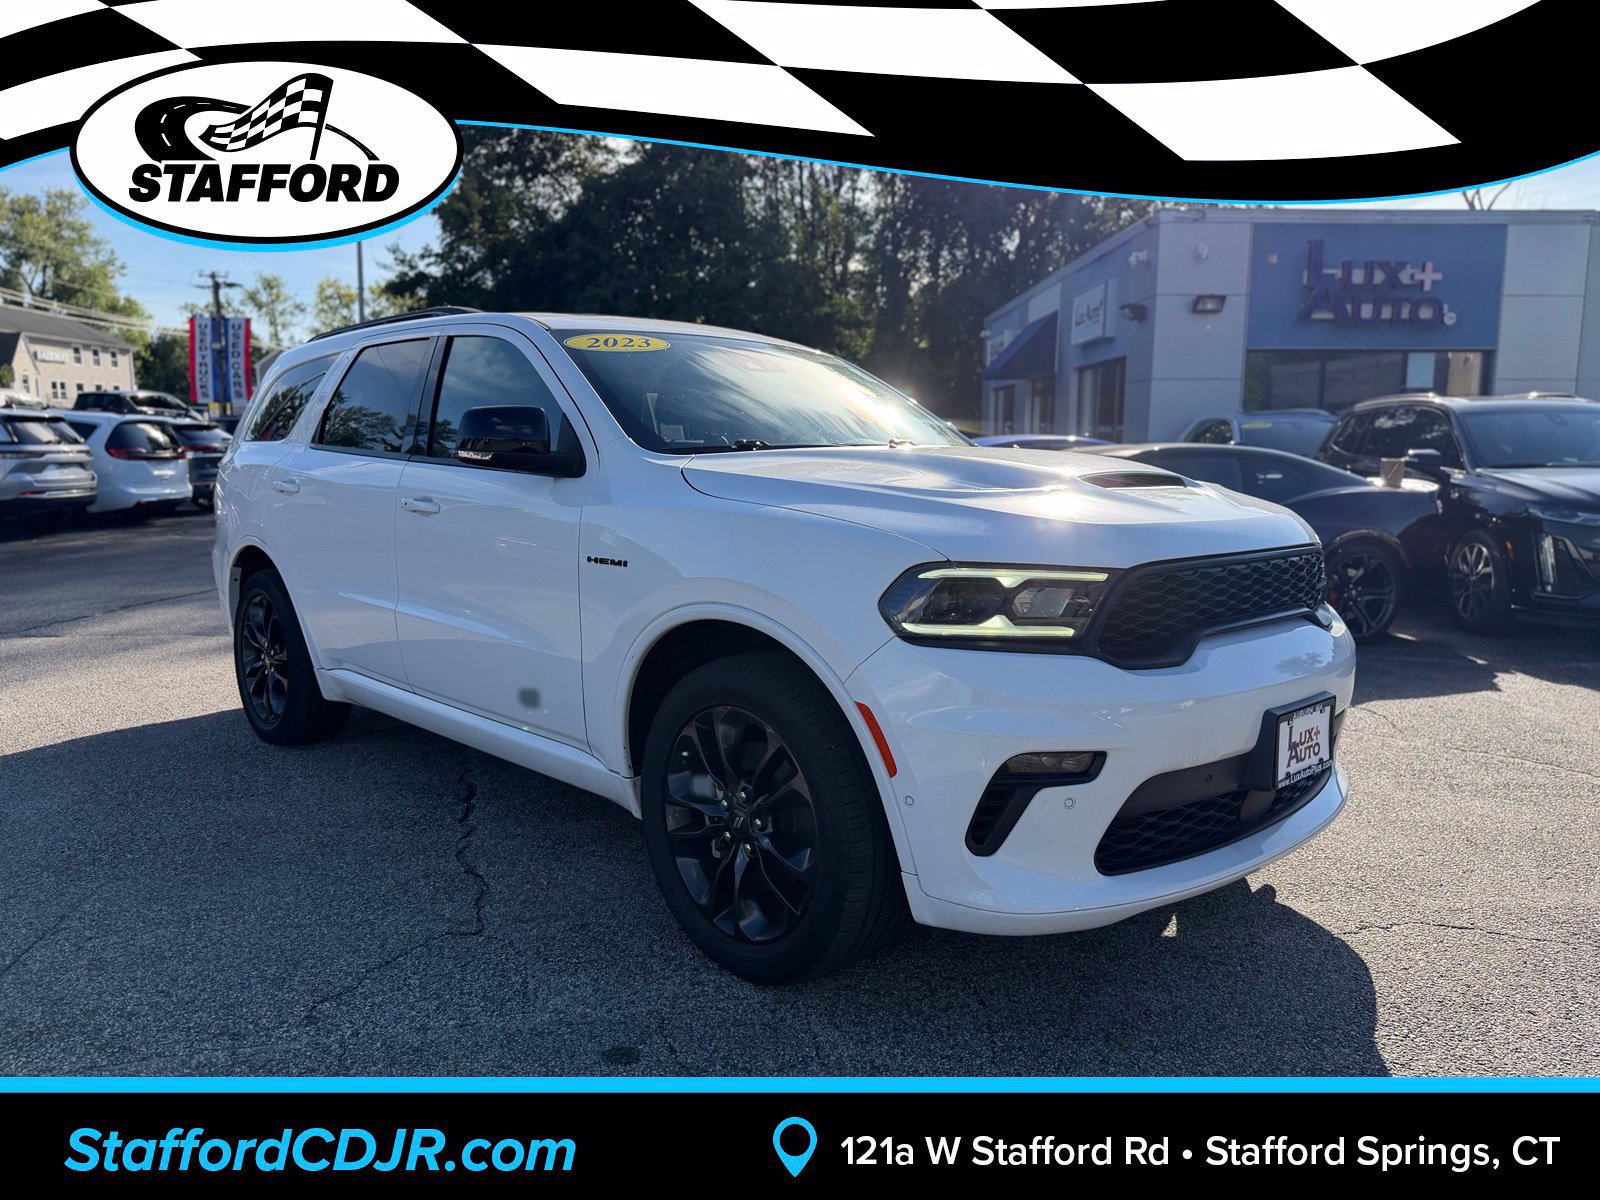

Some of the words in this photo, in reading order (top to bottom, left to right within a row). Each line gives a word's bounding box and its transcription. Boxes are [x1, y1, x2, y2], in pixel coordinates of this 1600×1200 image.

[198, 322, 208, 352] USED
[231, 322, 242, 356] USED
[586, 337, 651, 348] 2023
[199, 353, 209, 397] TRUCKS
[231, 361, 243, 399] CARS
[586, 556, 628, 567] HEMI
[1286, 740, 1321, 769] AUTO
